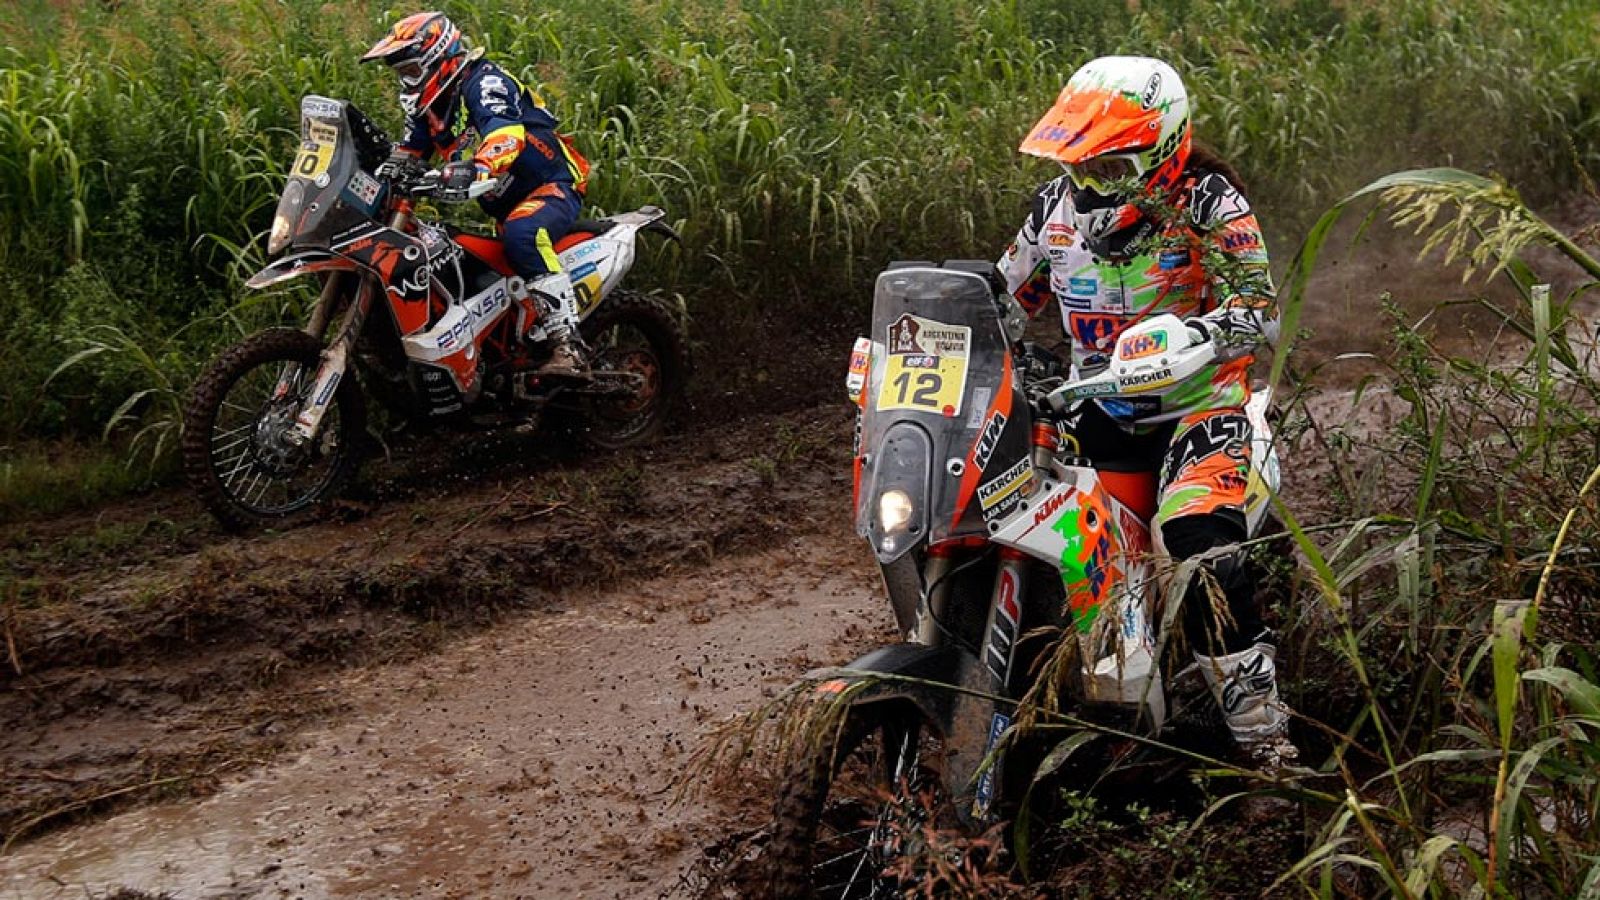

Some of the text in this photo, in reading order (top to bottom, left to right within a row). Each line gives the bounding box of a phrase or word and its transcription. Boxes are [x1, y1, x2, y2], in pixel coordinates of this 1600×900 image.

[923, 330, 966, 341] ARGENTINA
[893, 372, 942, 406] 12
[974, 411, 1005, 471] KTM
